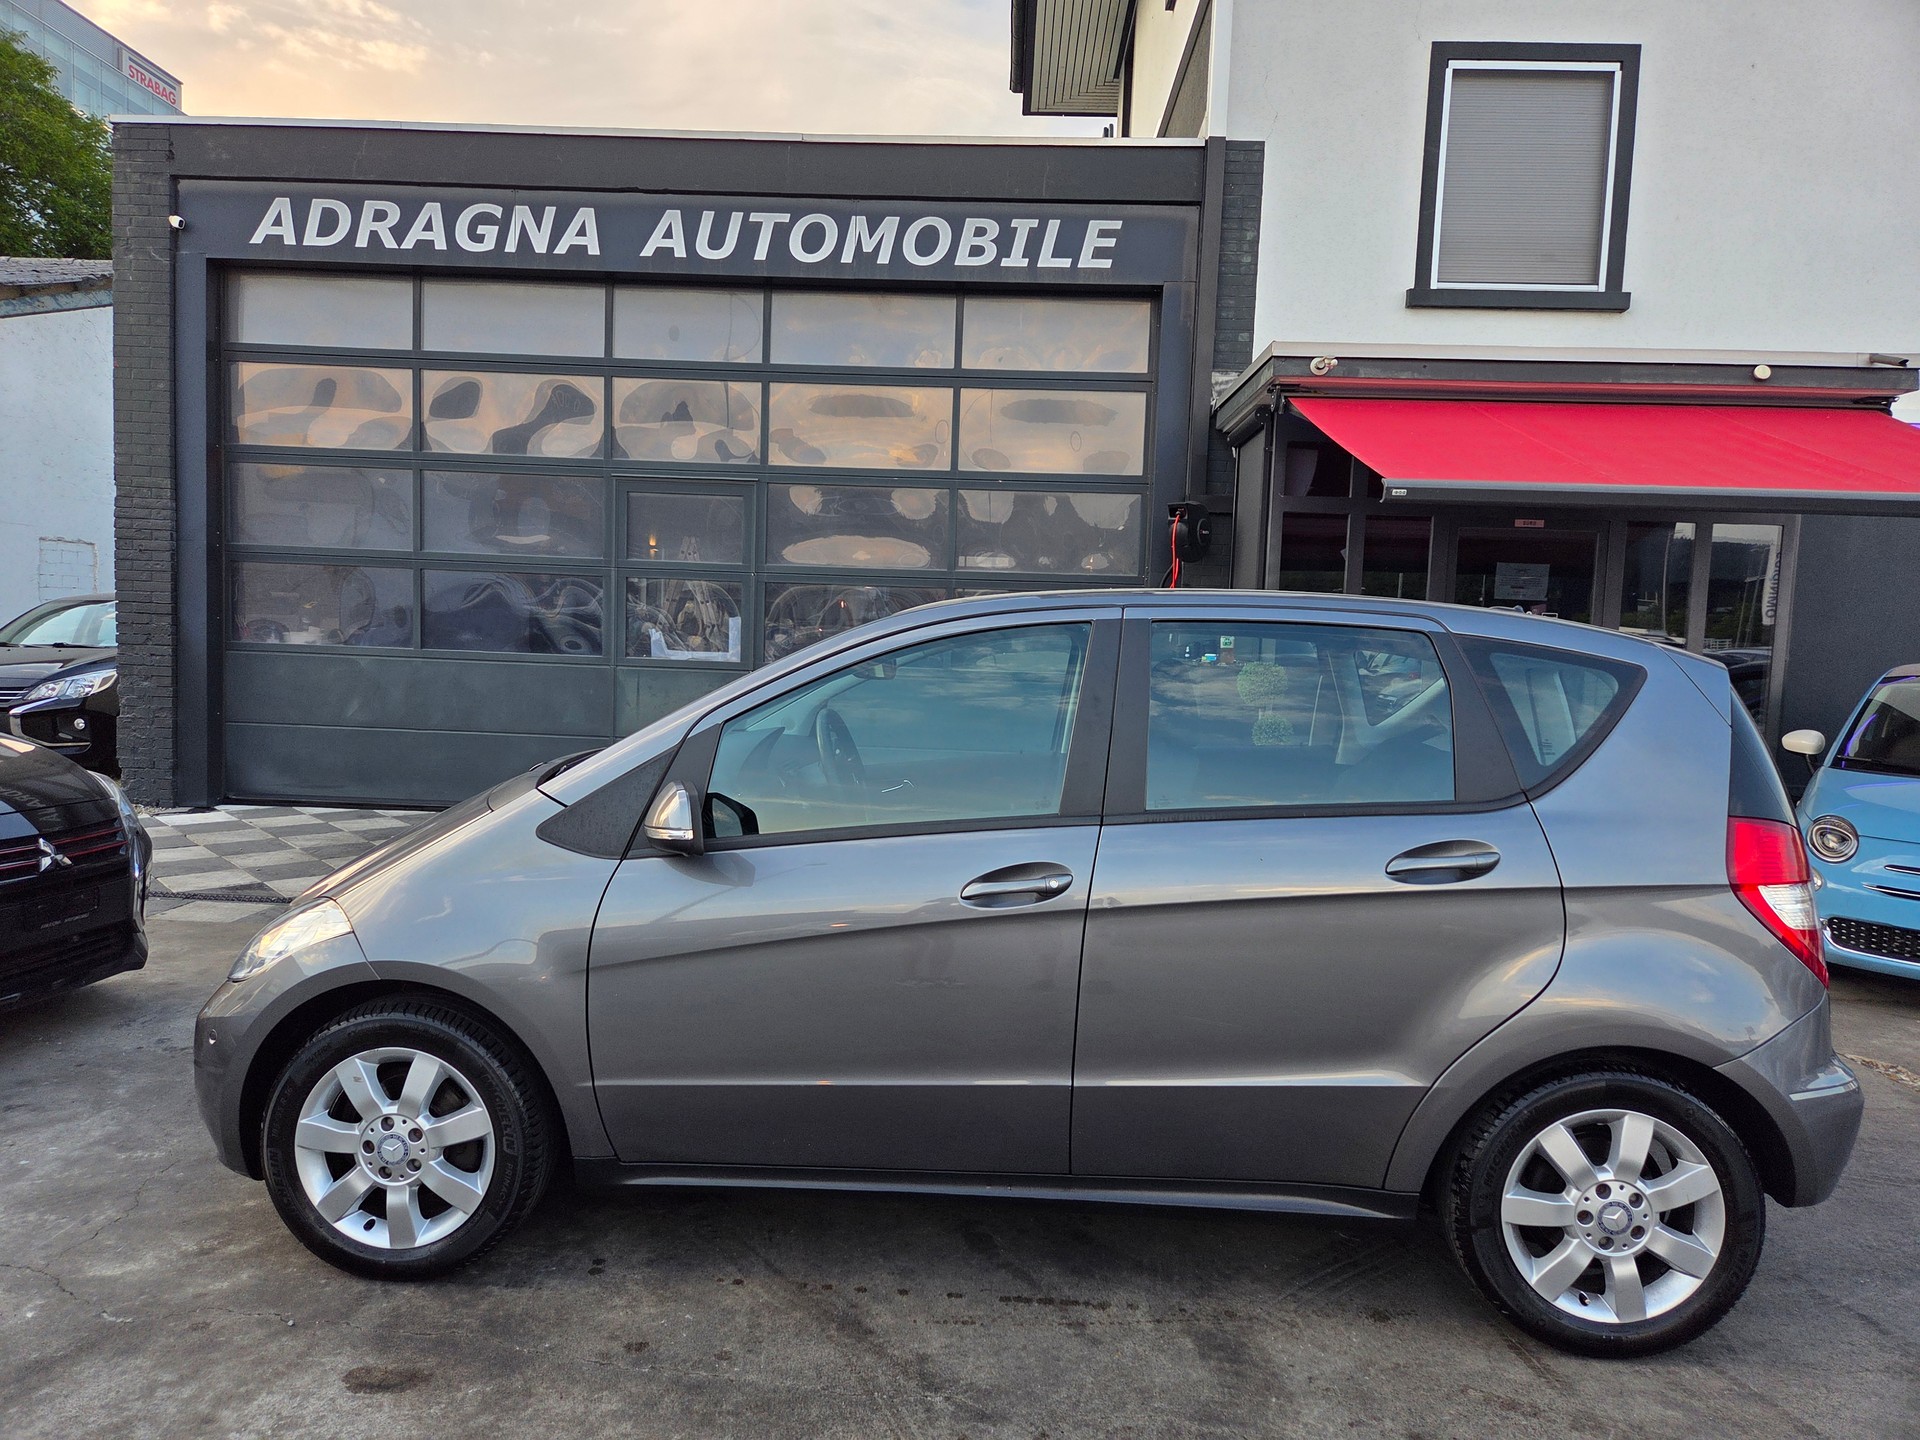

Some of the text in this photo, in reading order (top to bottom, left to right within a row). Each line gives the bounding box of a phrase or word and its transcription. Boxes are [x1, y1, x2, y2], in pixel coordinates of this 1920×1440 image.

[128, 64, 176, 105] STRABAG
[249, 197, 1123, 268] ADRAGNA AUTOMOBILE
